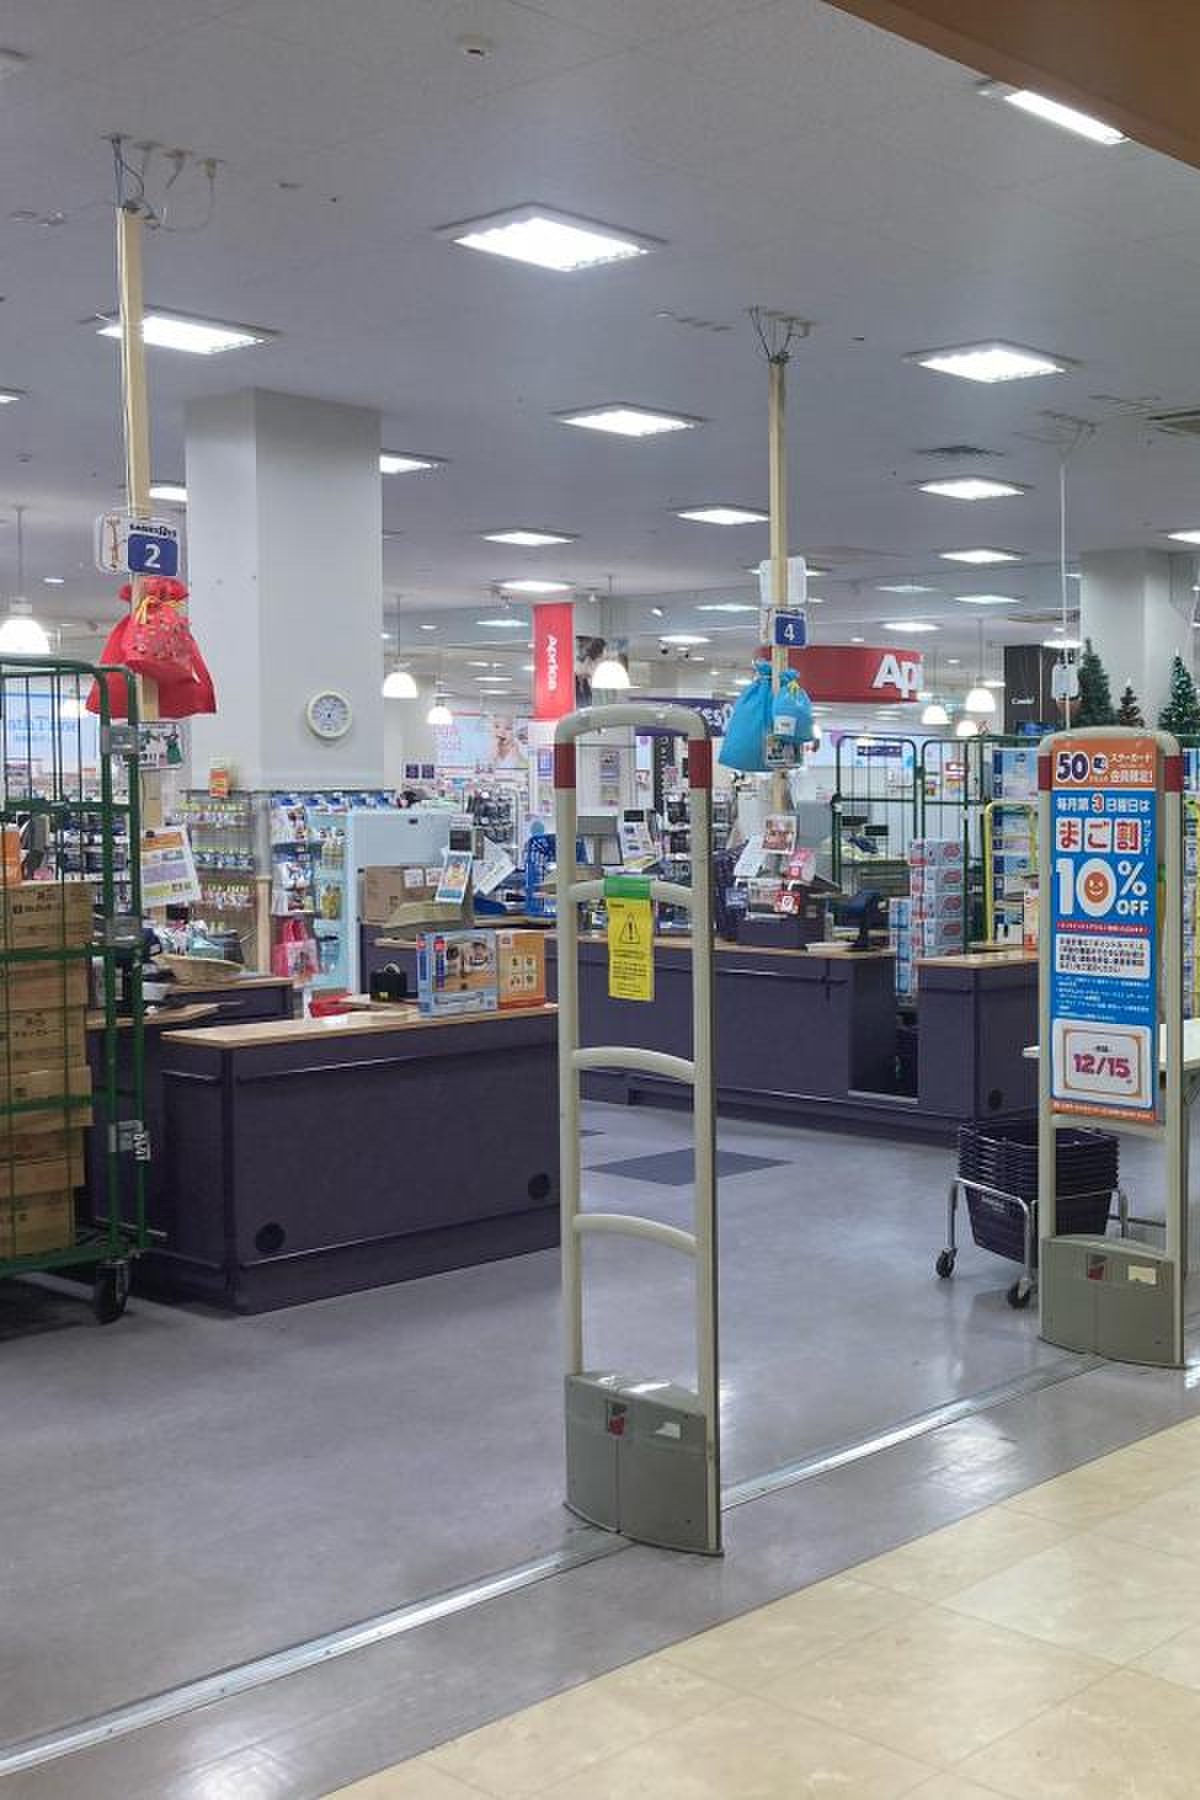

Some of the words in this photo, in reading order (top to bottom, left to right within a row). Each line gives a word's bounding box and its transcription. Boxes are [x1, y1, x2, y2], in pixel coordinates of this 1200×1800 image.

[144, 544, 161, 569] 2
[783, 624, 795, 641] 4
[546, 634, 557, 690] Aprica
[1056, 752, 1089, 783] 50
[1056, 817, 1141, 854] まご割
[1116, 899, 1150, 917] OFF
[1073, 1053, 1131, 1080] 12/15
